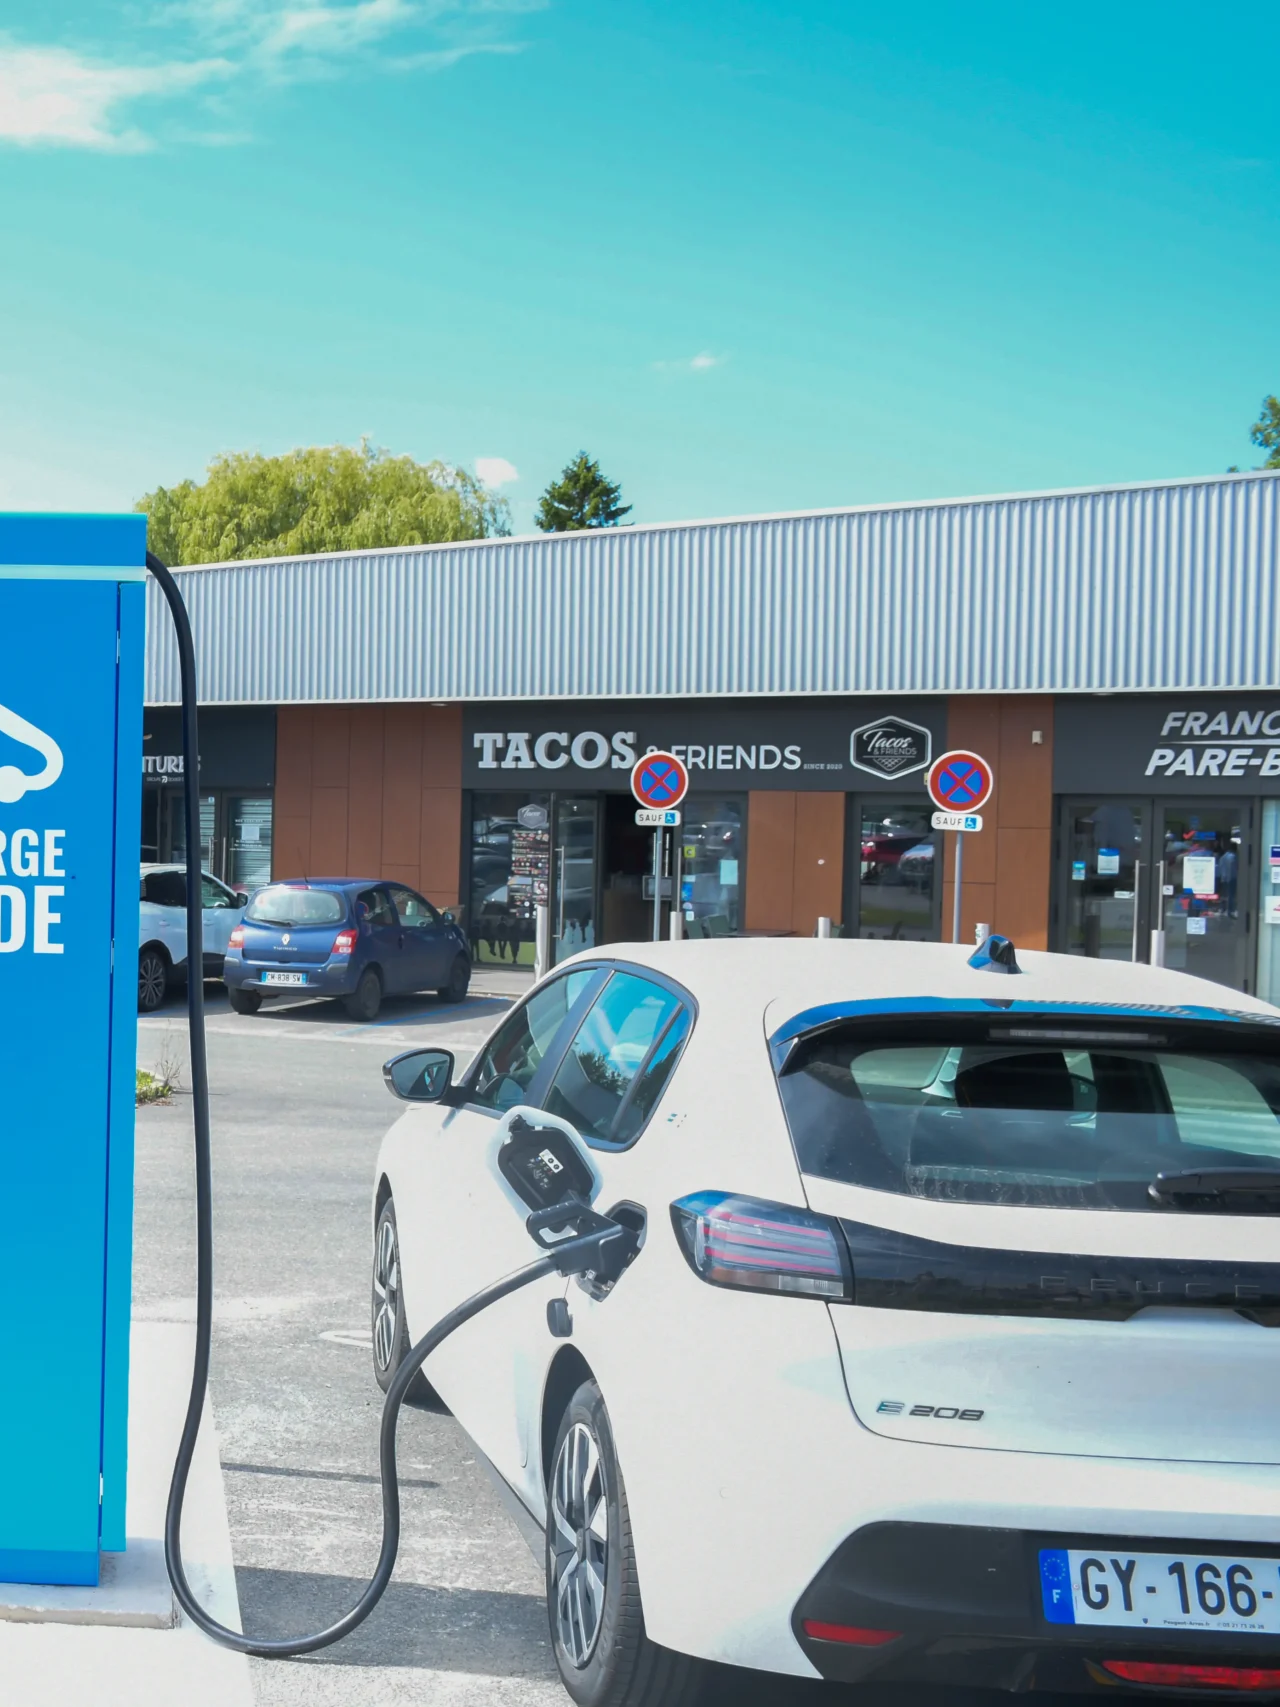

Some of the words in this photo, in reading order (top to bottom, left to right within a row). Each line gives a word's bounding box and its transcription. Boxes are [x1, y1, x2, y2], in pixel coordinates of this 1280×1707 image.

[1160, 710, 1280, 736] FRANC
[473, 731, 636, 769] TACOS
[671, 745, 801, 770] FRIENDS
[863, 728, 912, 752] Tacos
[1144, 748, 1280, 776] PARE-B
[639, 814, 663, 822] SAUF
[936, 817, 963, 826] SAUF
[909, 1405, 985, 1421] 208
[1053, 1589, 1061, 1604] F
[1080, 1557, 1280, 1617] GY-166-
